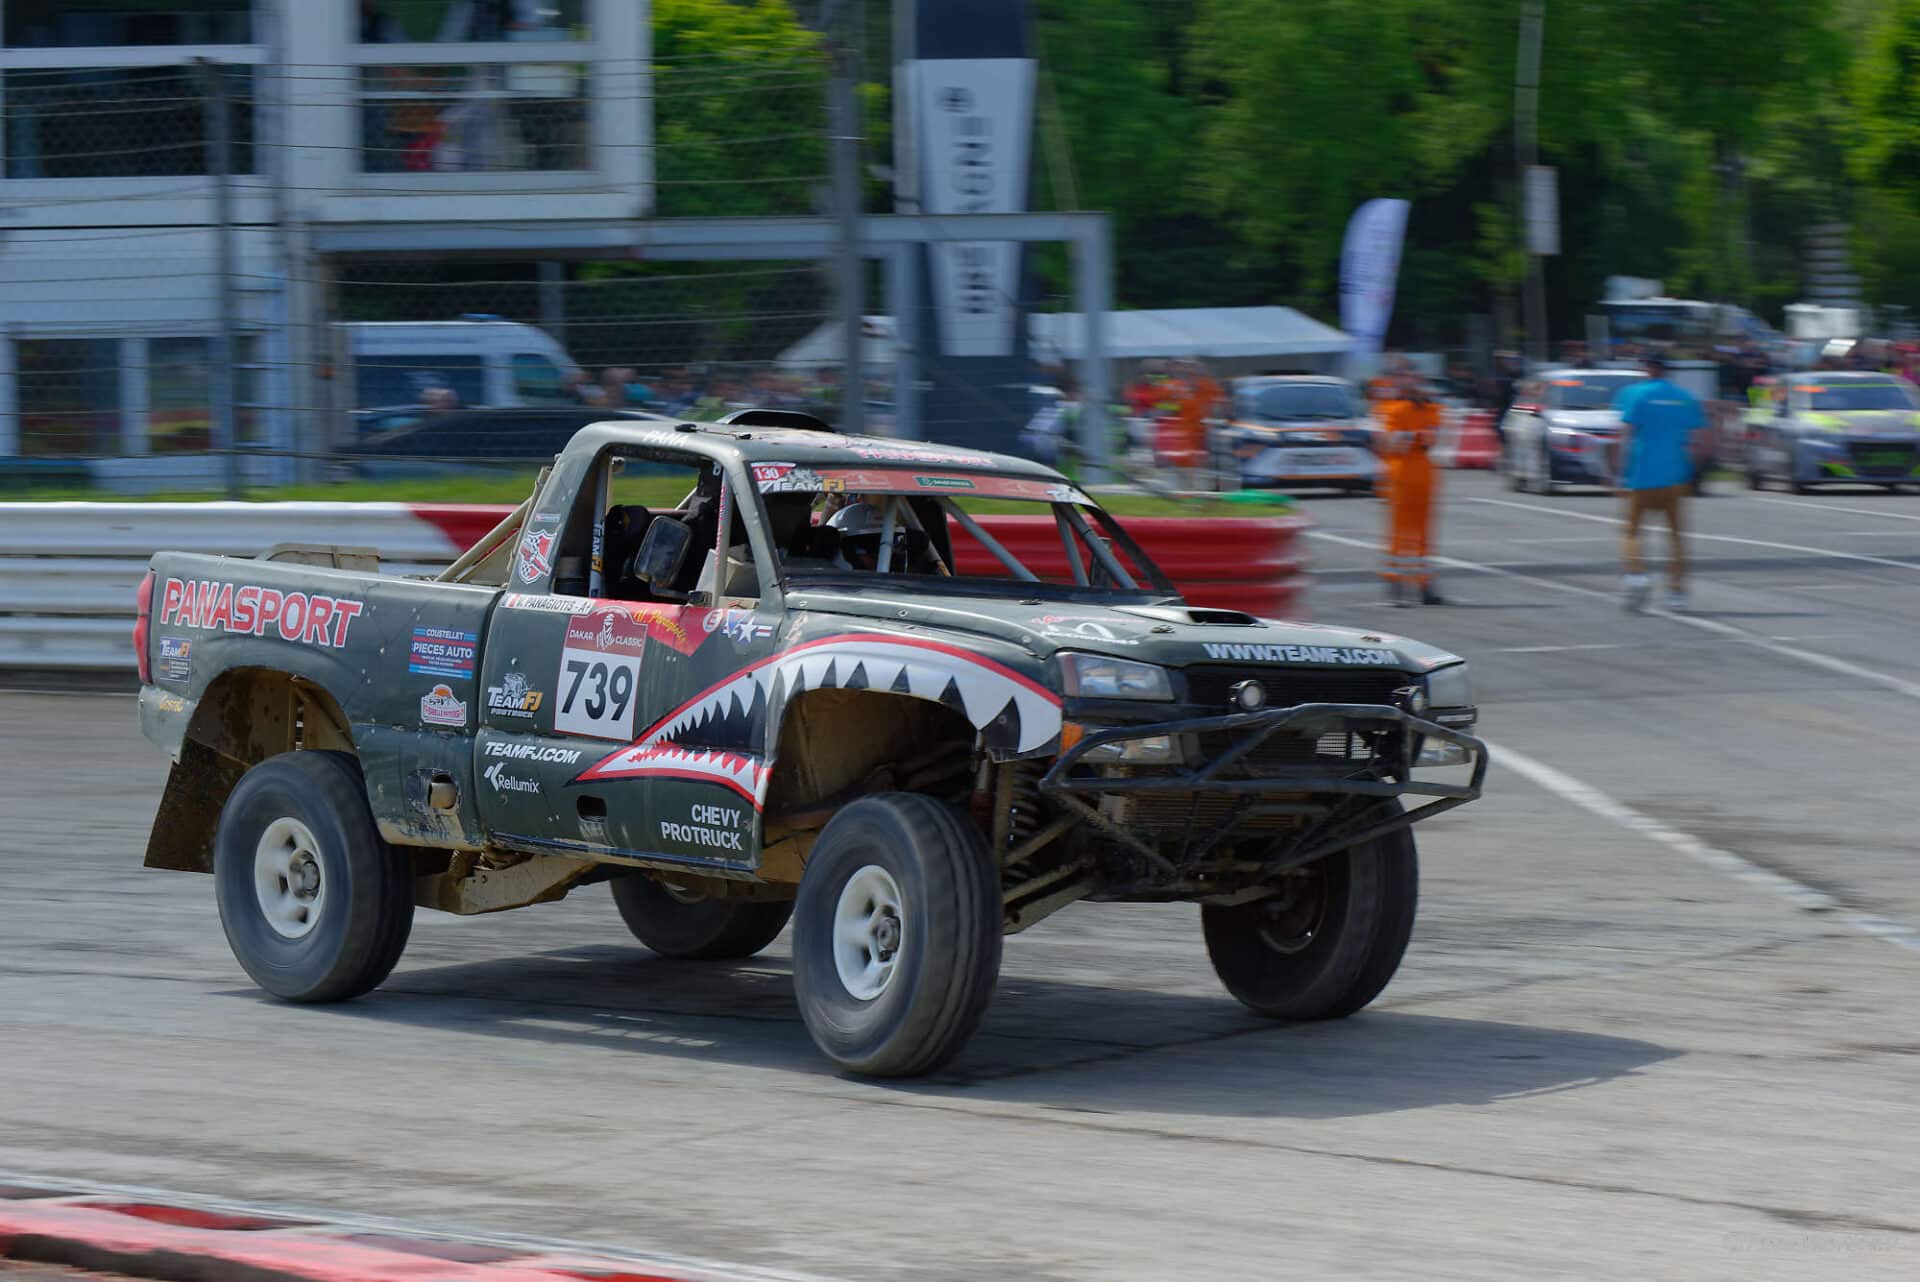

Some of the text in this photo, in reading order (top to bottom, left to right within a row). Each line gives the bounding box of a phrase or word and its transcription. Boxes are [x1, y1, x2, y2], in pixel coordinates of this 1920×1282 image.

[755, 466, 780, 480] 130
[160, 578, 363, 647] PANASPORT
[426, 629, 464, 640] COUSTELLET
[569, 629, 643, 648] DAKAR CLASSIC
[413, 642, 473, 658] PIECES AUTO
[1202, 643, 1399, 665] WWW.TEAMFJ.COM
[488, 687, 543, 711] TEAMFJ
[562, 660, 633, 721] 739
[484, 742, 581, 765] TEAMFJ.COM
[498, 774, 539, 794] Rellumix
[691, 804, 741, 827] CHEVY
[661, 821, 743, 851] PROTRUCK
